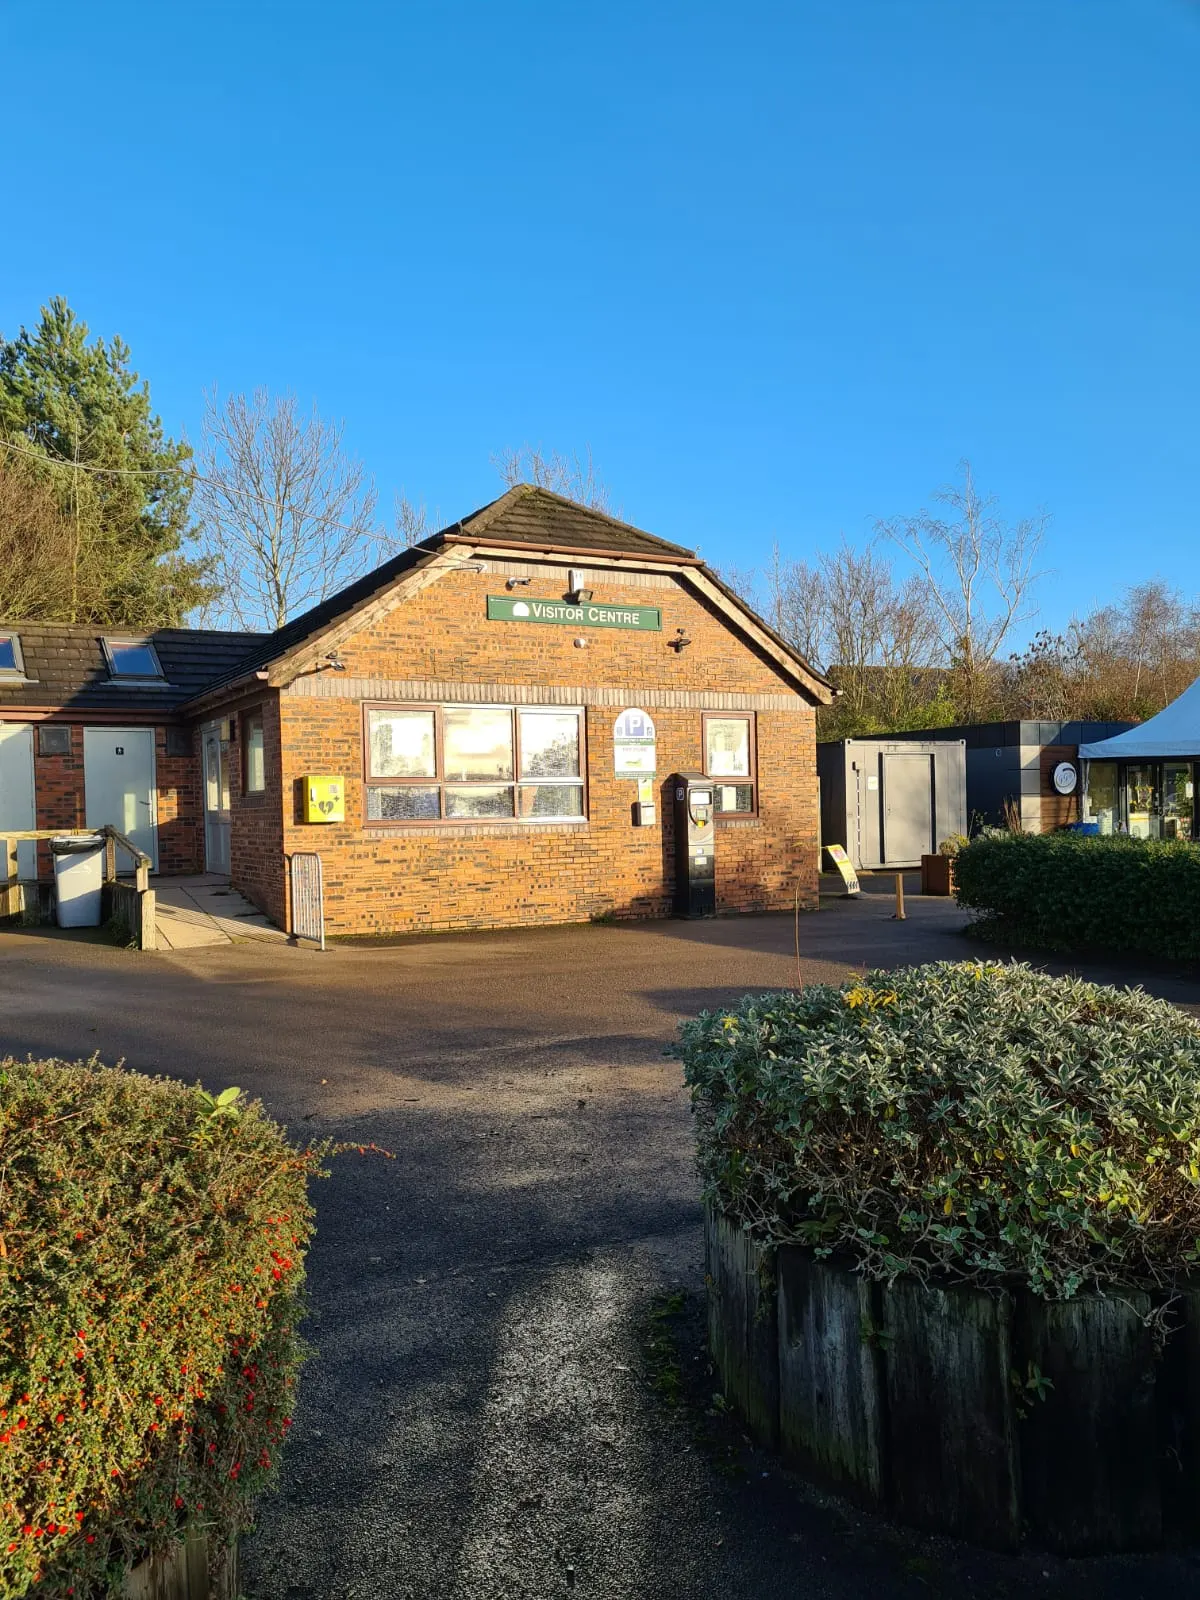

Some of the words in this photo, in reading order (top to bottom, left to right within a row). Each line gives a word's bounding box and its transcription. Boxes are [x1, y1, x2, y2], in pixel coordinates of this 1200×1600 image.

[532, 603, 584, 620] VISITOR
[588, 607, 640, 625] CENTRE
[629, 715, 642, 735] P
